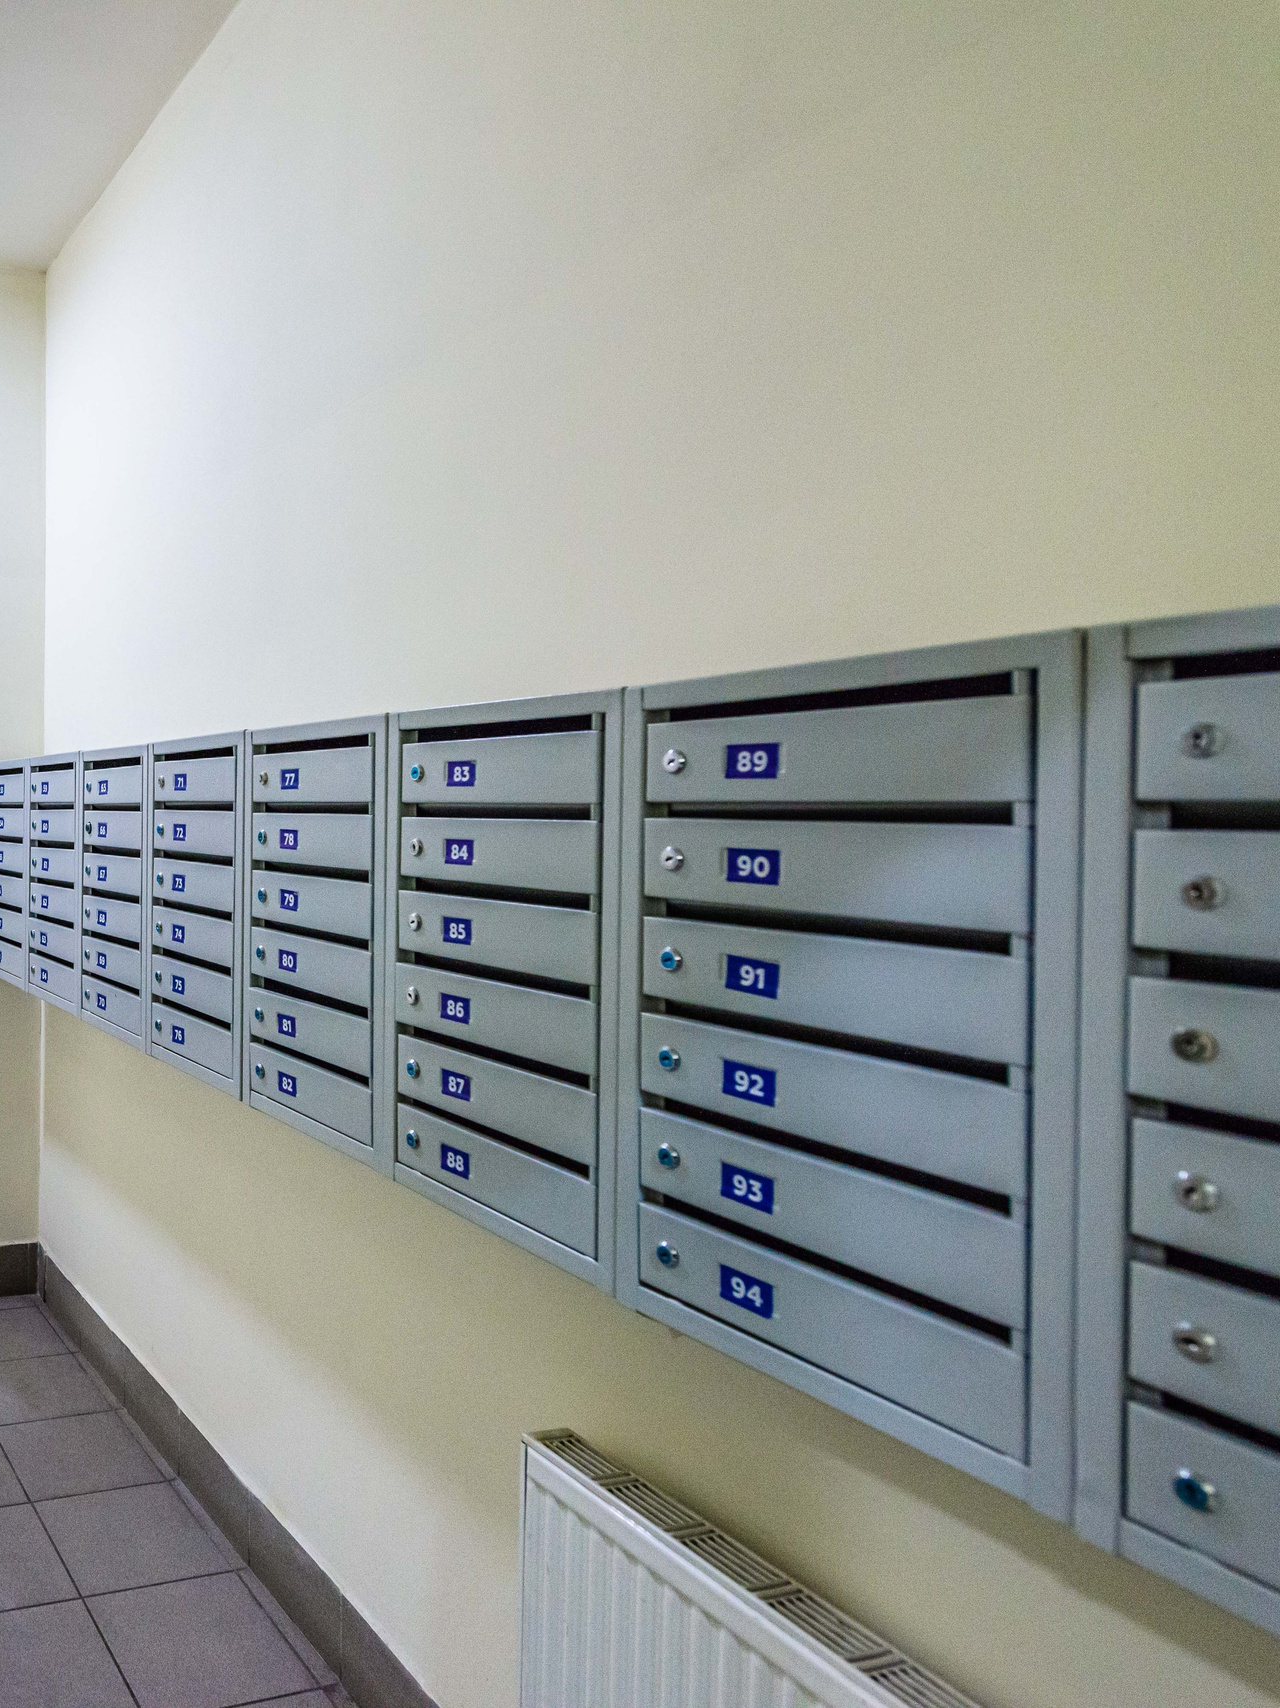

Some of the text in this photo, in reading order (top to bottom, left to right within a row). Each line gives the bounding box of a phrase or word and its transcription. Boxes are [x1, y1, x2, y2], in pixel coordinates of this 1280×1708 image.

[736, 751, 768, 772] 89
[284, 773, 296, 786] 77
[453, 767, 470, 781] 83
[177, 777, 184, 788] 71
[175, 827, 184, 839] 72
[283, 832, 295, 846] 78
[450, 845, 469, 860] 84
[736, 856, 770, 877] 90
[175, 877, 183, 889] 73
[283, 892, 295, 907] 79
[174, 928, 183, 940] 74
[449, 923, 466, 939] 85
[282, 953, 294, 968] 80
[174, 979, 183, 991] 75
[740, 965, 766, 990] 91
[446, 1000, 465, 1017] 86
[282, 1018, 292, 1033] 81
[174, 1029, 183, 1041] 76
[282, 1076, 293, 1092] 82
[448, 1077, 465, 1093] 87
[735, 1071, 765, 1096] 92
[446, 1152, 465, 1171] 88
[733, 1175, 763, 1202] 93
[730, 1277, 763, 1306] 94
